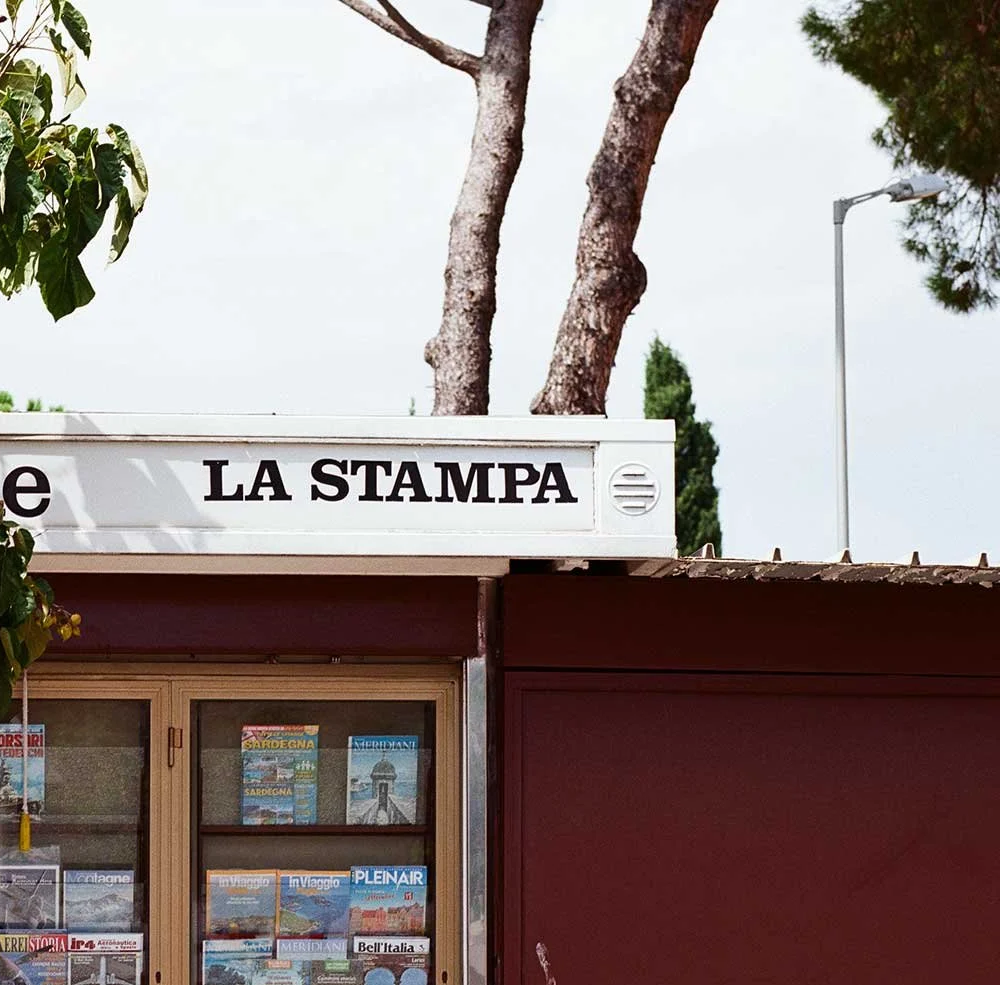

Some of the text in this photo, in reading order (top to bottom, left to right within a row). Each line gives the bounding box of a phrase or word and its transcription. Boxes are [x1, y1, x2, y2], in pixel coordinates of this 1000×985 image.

[203, 459, 578, 504] LA STAMPA
[243, 739, 315, 750] SARDEGNA
[353, 741, 414, 751] MERIDIANI
[244, 788, 293, 797] SARDEGNA
[355, 870, 424, 888] PLEINAIR
[281, 942, 346, 952] MERIDIANI
[358, 942, 415, 953] Bell'Italia
